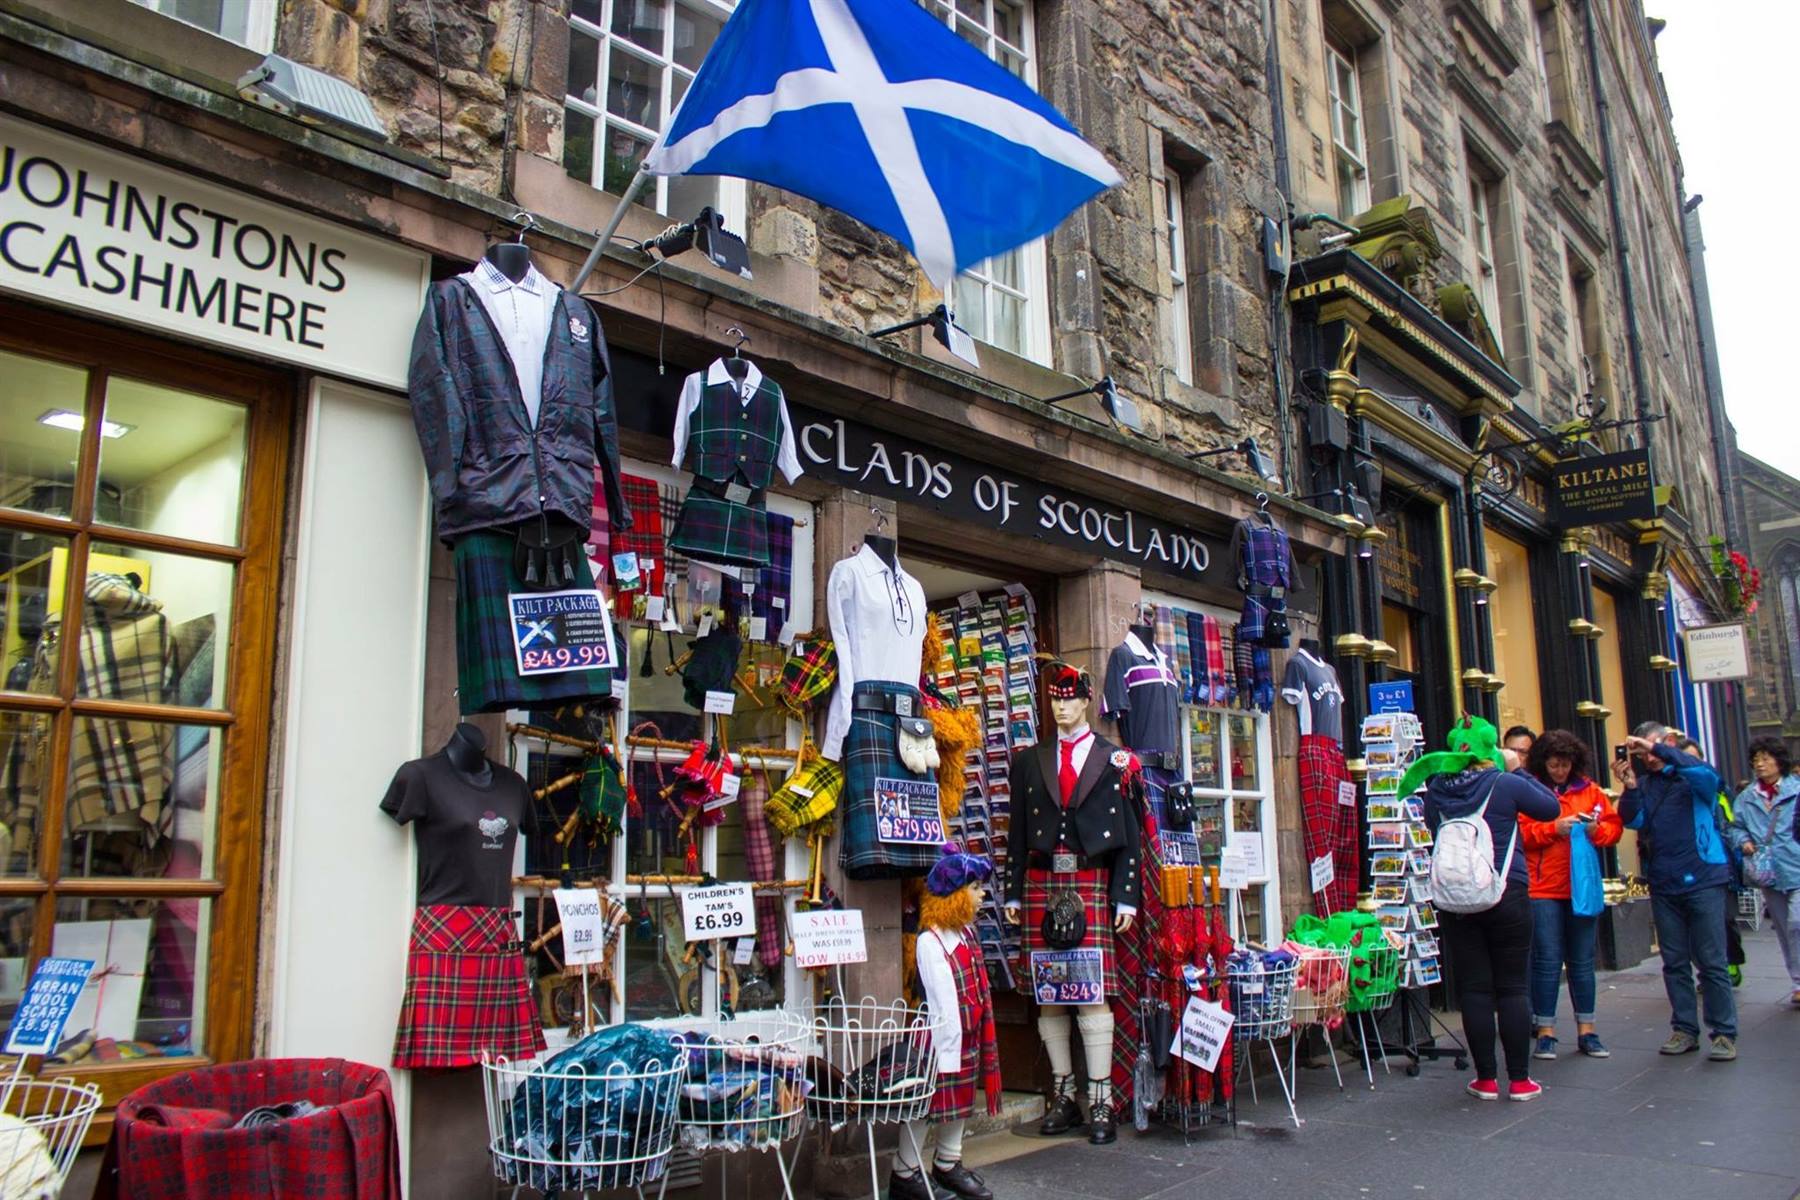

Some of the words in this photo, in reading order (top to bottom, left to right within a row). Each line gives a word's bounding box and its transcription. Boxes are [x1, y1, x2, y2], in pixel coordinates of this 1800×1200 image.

[0, 145, 347, 293] JOHNSTONS
[0, 220, 327, 349] CASHMERE
[1558, 461, 1649, 489] KILTANE
[800, 418, 953, 499] CLANS
[971, 473, 1020, 525] OF
[1037, 493, 1210, 572] SCOTLAND
[516, 599, 543, 615] KILT
[546, 595, 599, 612] PACKAGE
[1690, 628, 1739, 641] Edinburgh
[523, 645, 607, 669] £49.99
[1377, 691, 1385, 701] 3
[1395, 689, 1406, 699] £1
[897, 782, 937, 796] PACKAGE
[893, 818, 942, 842] £79.99
[687, 887, 745, 901] CHILDREN'S
[704, 901, 734, 912] TAM'S
[695, 911, 744, 931] £6.99
[810, 913, 849, 927] SALE
[812, 938, 832, 949] WAS
[797, 951, 829, 966] NOW
[30, 979, 81, 995] ARRAN
[1060, 982, 1101, 1002] £249
[30, 993, 68, 1007] WOOL
[21, 1005, 68, 1018] SCARF
[16, 1018, 59, 1032] £8.99
